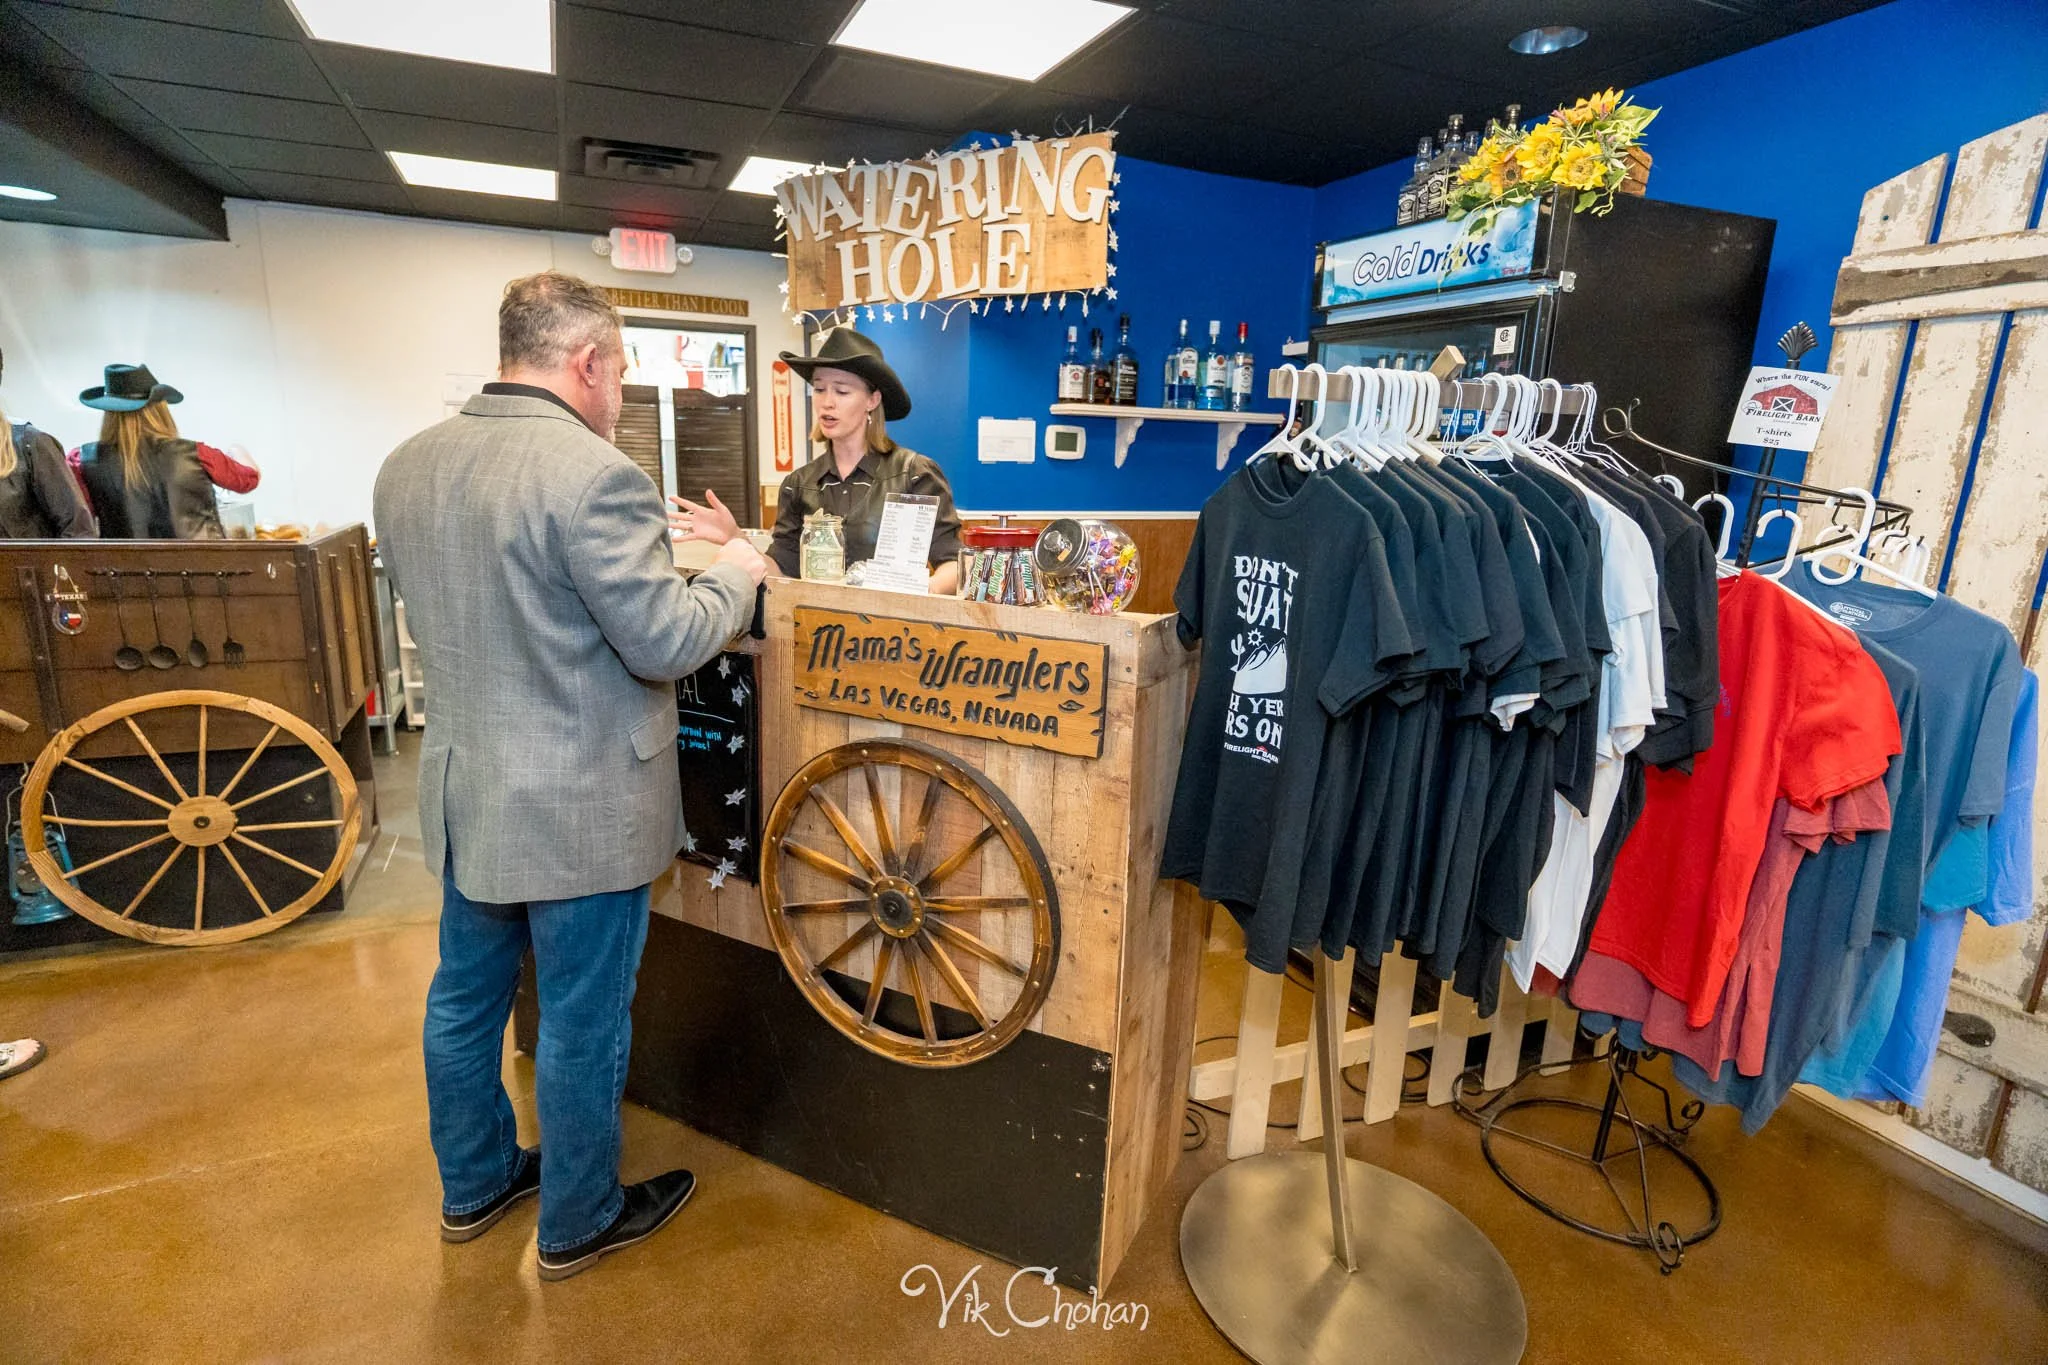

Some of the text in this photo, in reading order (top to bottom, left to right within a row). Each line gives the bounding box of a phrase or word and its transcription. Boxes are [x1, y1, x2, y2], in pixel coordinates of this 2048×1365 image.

[773, 140, 1117, 242] WATERING
[620, 230, 669, 273] EXIT
[835, 223, 1031, 307] HOLE
[1353, 241, 1420, 286] Cold
[611, 288, 746, 316] BETTER THAN I COOK
[1755, 375, 1778, 384] Where
[1794, 374, 1810, 382] FUN
[1745, 408, 1793, 420] FIRELIGHT
[1796, 413, 1821, 423] BARN
[1757, 427, 1792, 438] T-shirts
[807, 623, 1091, 702] Mama's Wranglers
[829, 678, 1060, 739] LAS VEGAS, NEVADA
[1248, 697, 1284, 717] YER
[1255, 718, 1283, 750] ON
